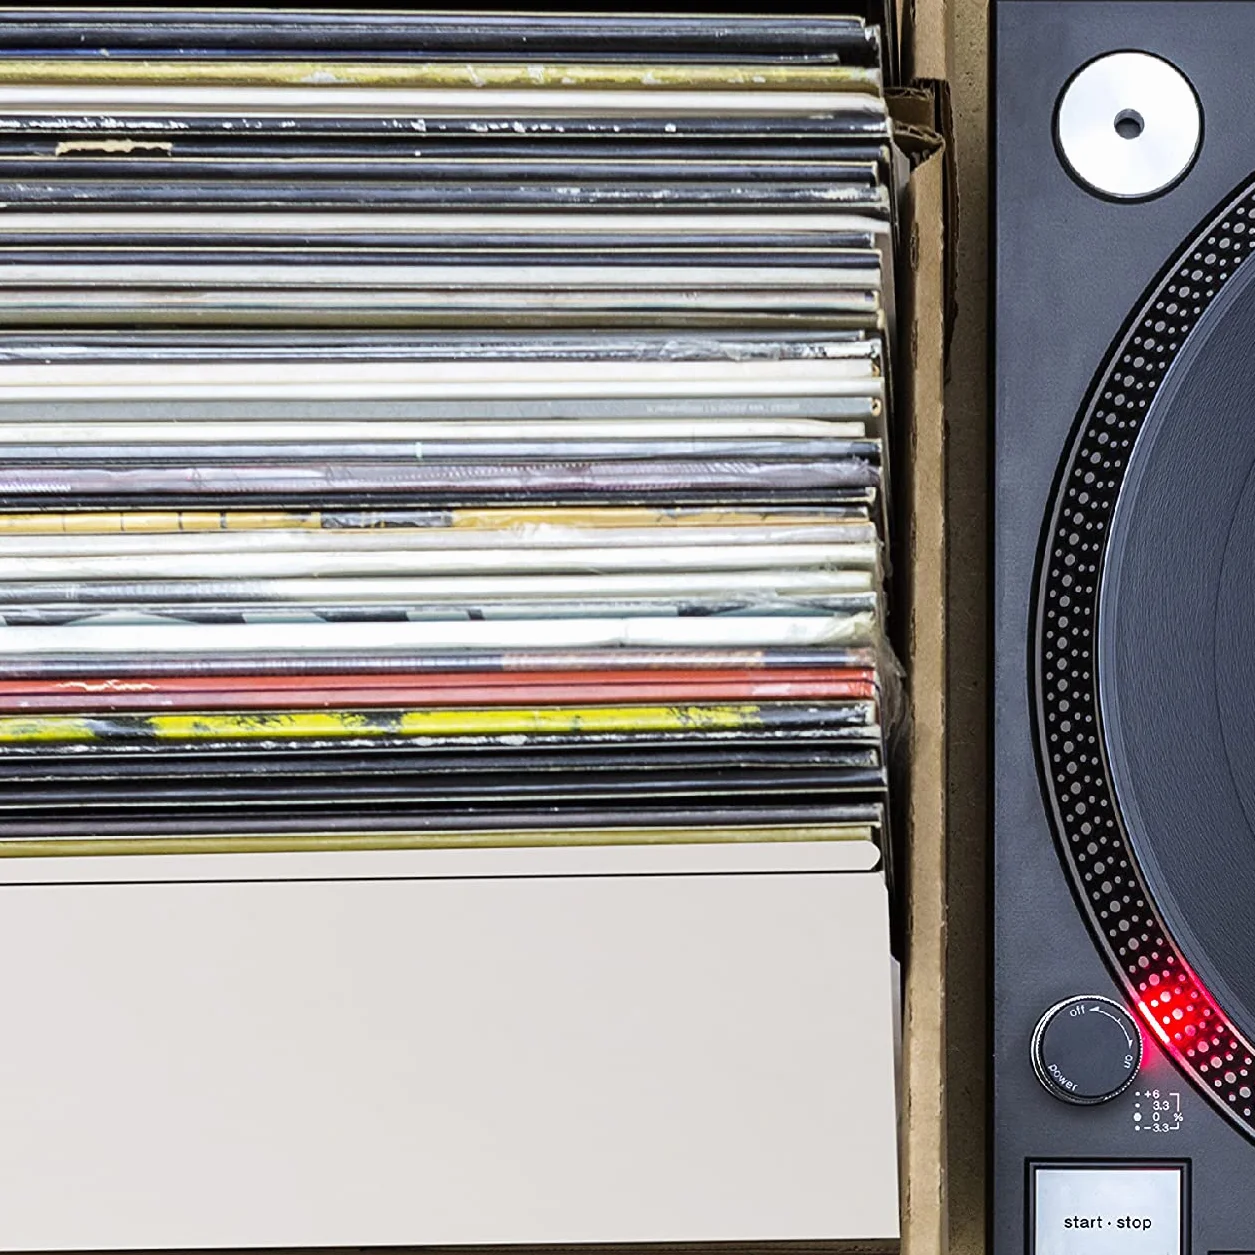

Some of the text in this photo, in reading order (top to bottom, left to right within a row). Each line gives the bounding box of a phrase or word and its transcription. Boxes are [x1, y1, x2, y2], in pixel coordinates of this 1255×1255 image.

[1069, 1005, 1085, 1017] off
[1123, 1054, 1133, 1069] on
[1047, 1063, 1079, 1092] power
[1144, 1089, 1160, 1099] +6
[1152, 1100, 1170, 1111] 3.3
[1152, 1111, 1184, 1122] 0 %
[1143, 1122, 1170, 1133] -3.3
[1064, 1215, 1103, 1229] start
[1116, 1215, 1152, 1231] stop
